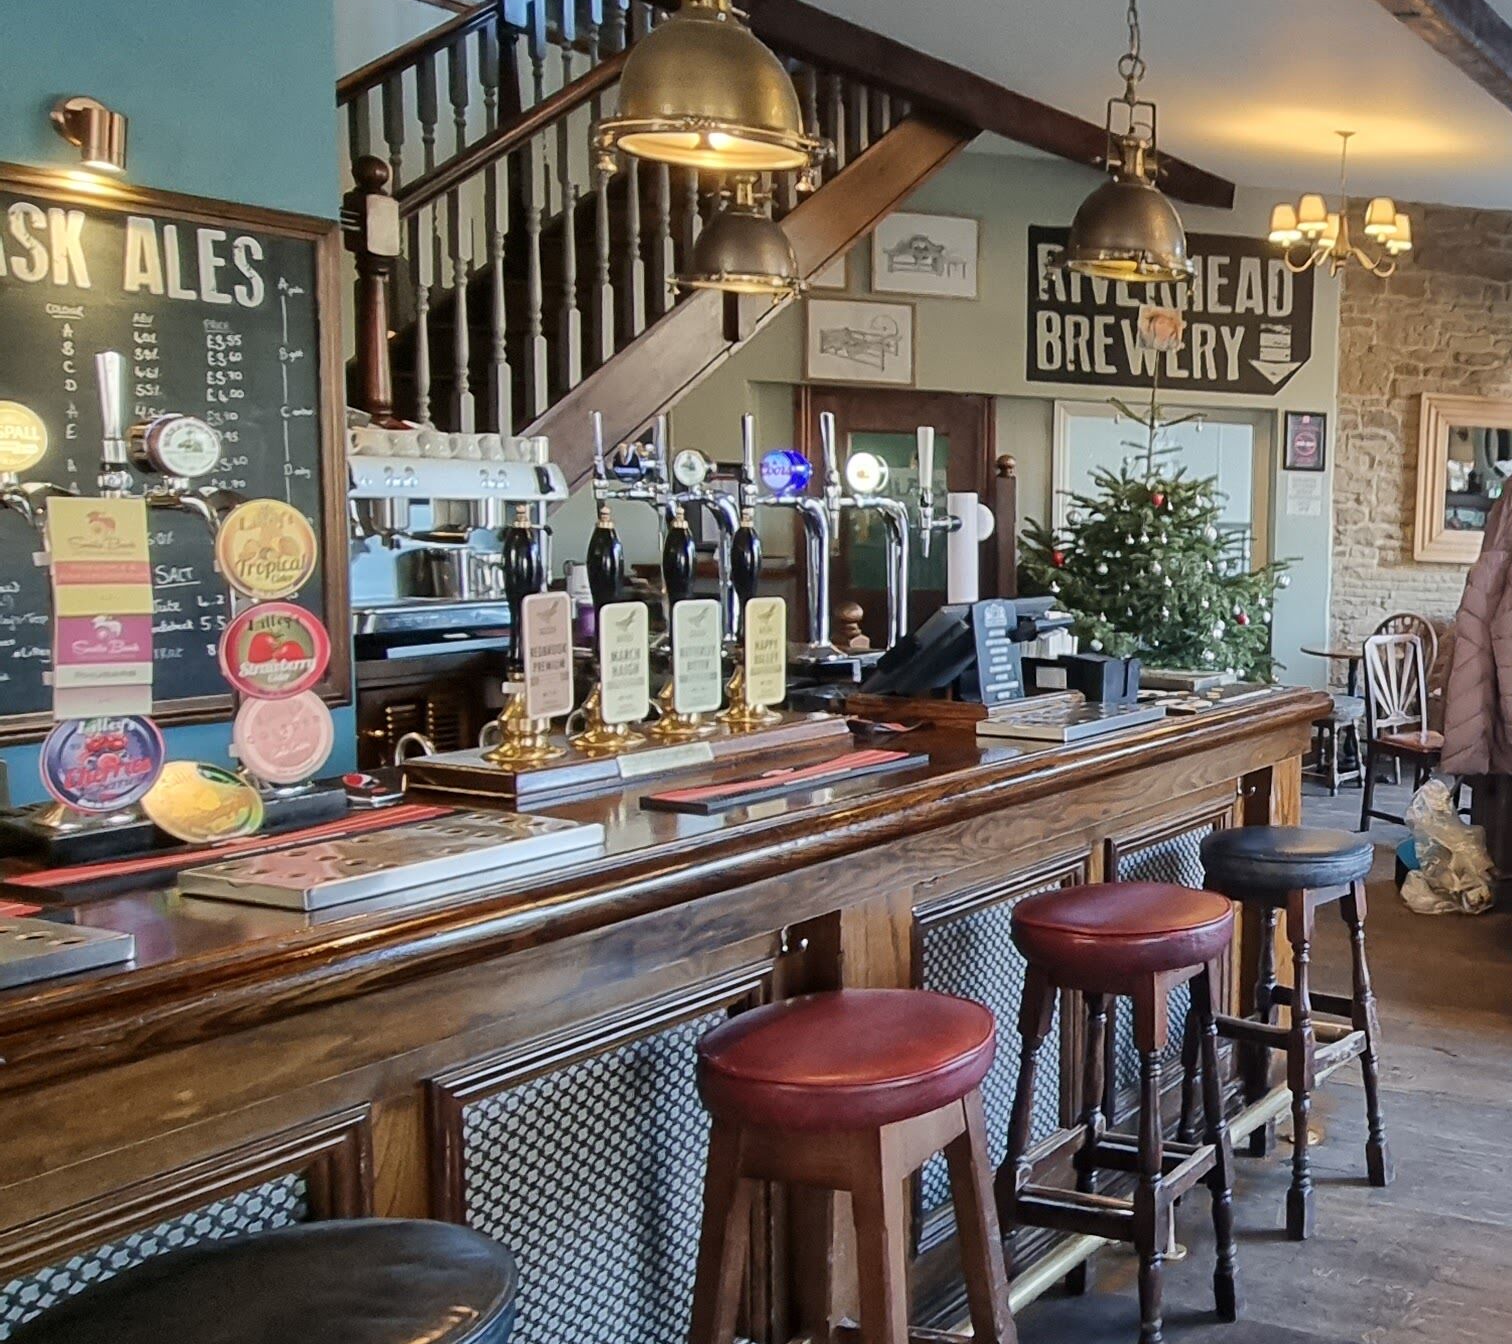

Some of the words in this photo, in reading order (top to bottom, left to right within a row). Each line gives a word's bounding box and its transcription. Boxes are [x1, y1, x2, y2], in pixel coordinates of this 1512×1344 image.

[0, 202, 92, 288] SK
[124, 215, 264, 308] ALES
[1035, 309, 1246, 382] BREWERY
[236, 555, 307, 580] Tropical
